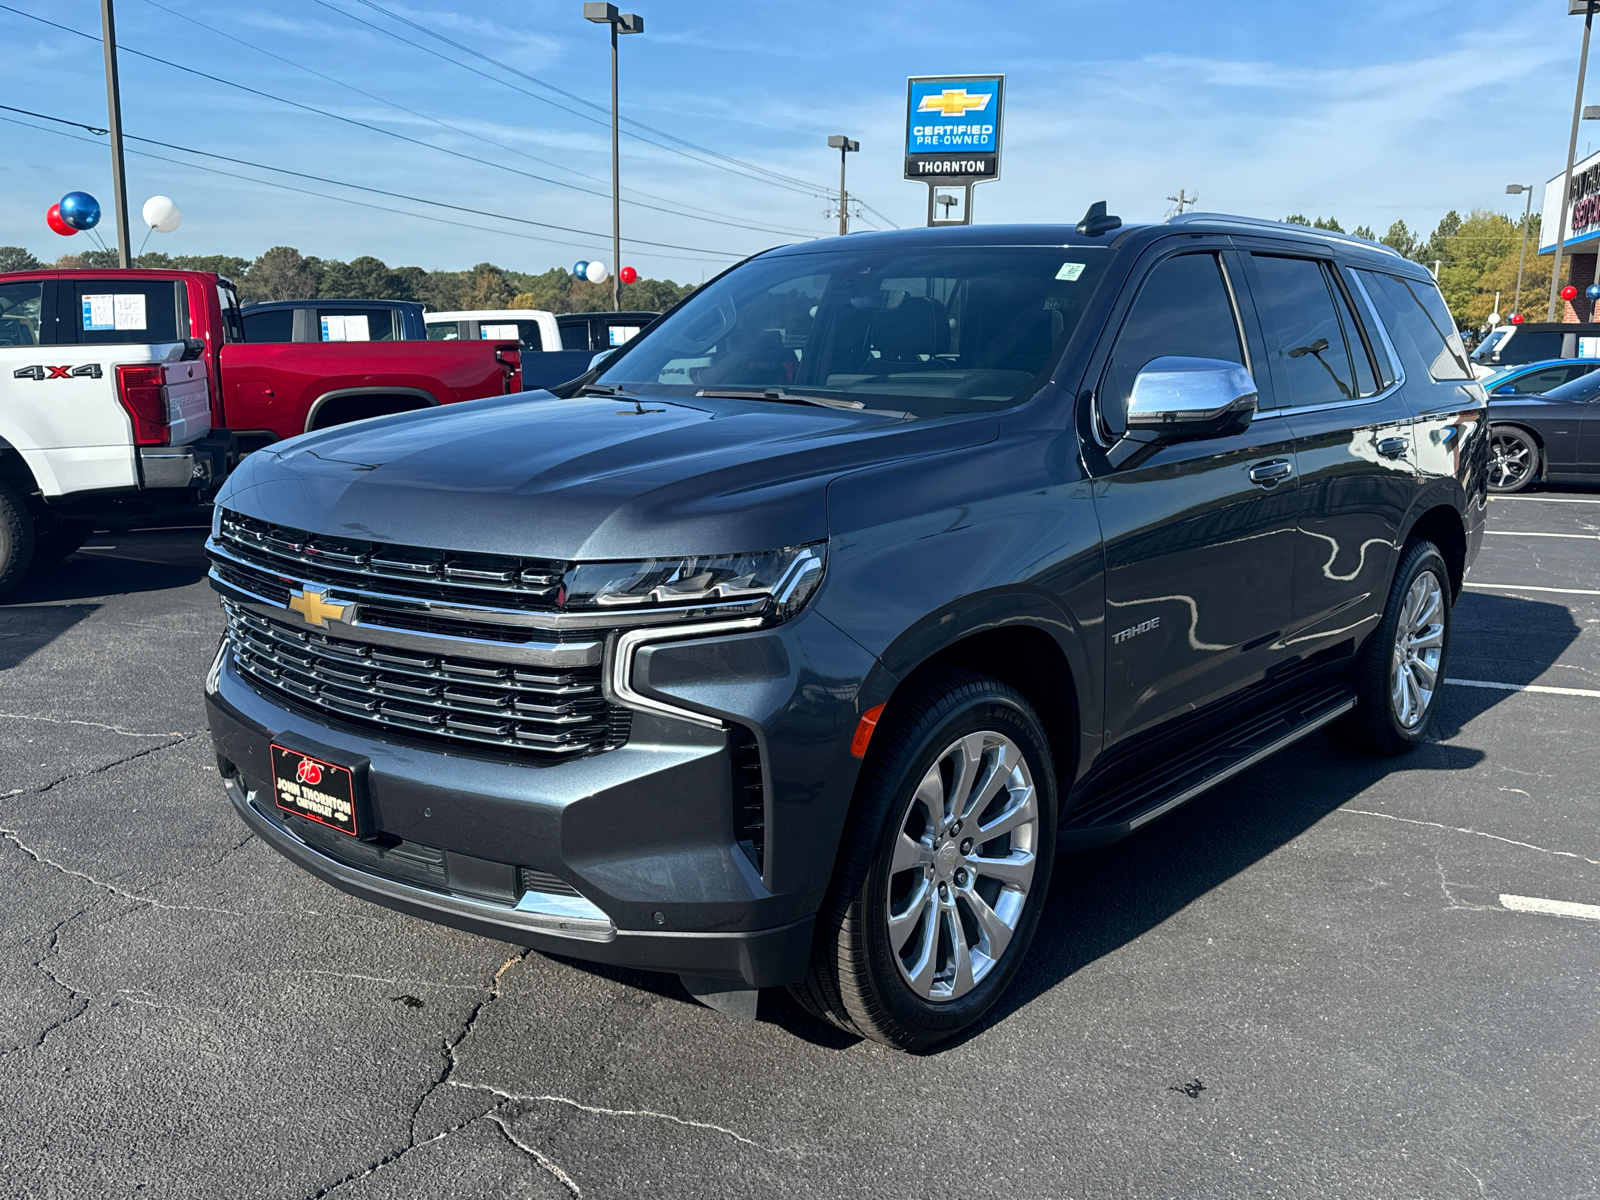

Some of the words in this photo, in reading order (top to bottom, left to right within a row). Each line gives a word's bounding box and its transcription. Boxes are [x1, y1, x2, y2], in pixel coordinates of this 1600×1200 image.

[913, 125, 993, 136] CERTIFIED
[916, 135, 988, 145] PRE-OWNED
[918, 160, 985, 173] THORNTON
[1111, 616, 1160, 645] TAHOE
[276, 777, 301, 796] JOHN
[301, 786, 352, 815] THORNTON
[296, 796, 333, 818] CHEVROLET
